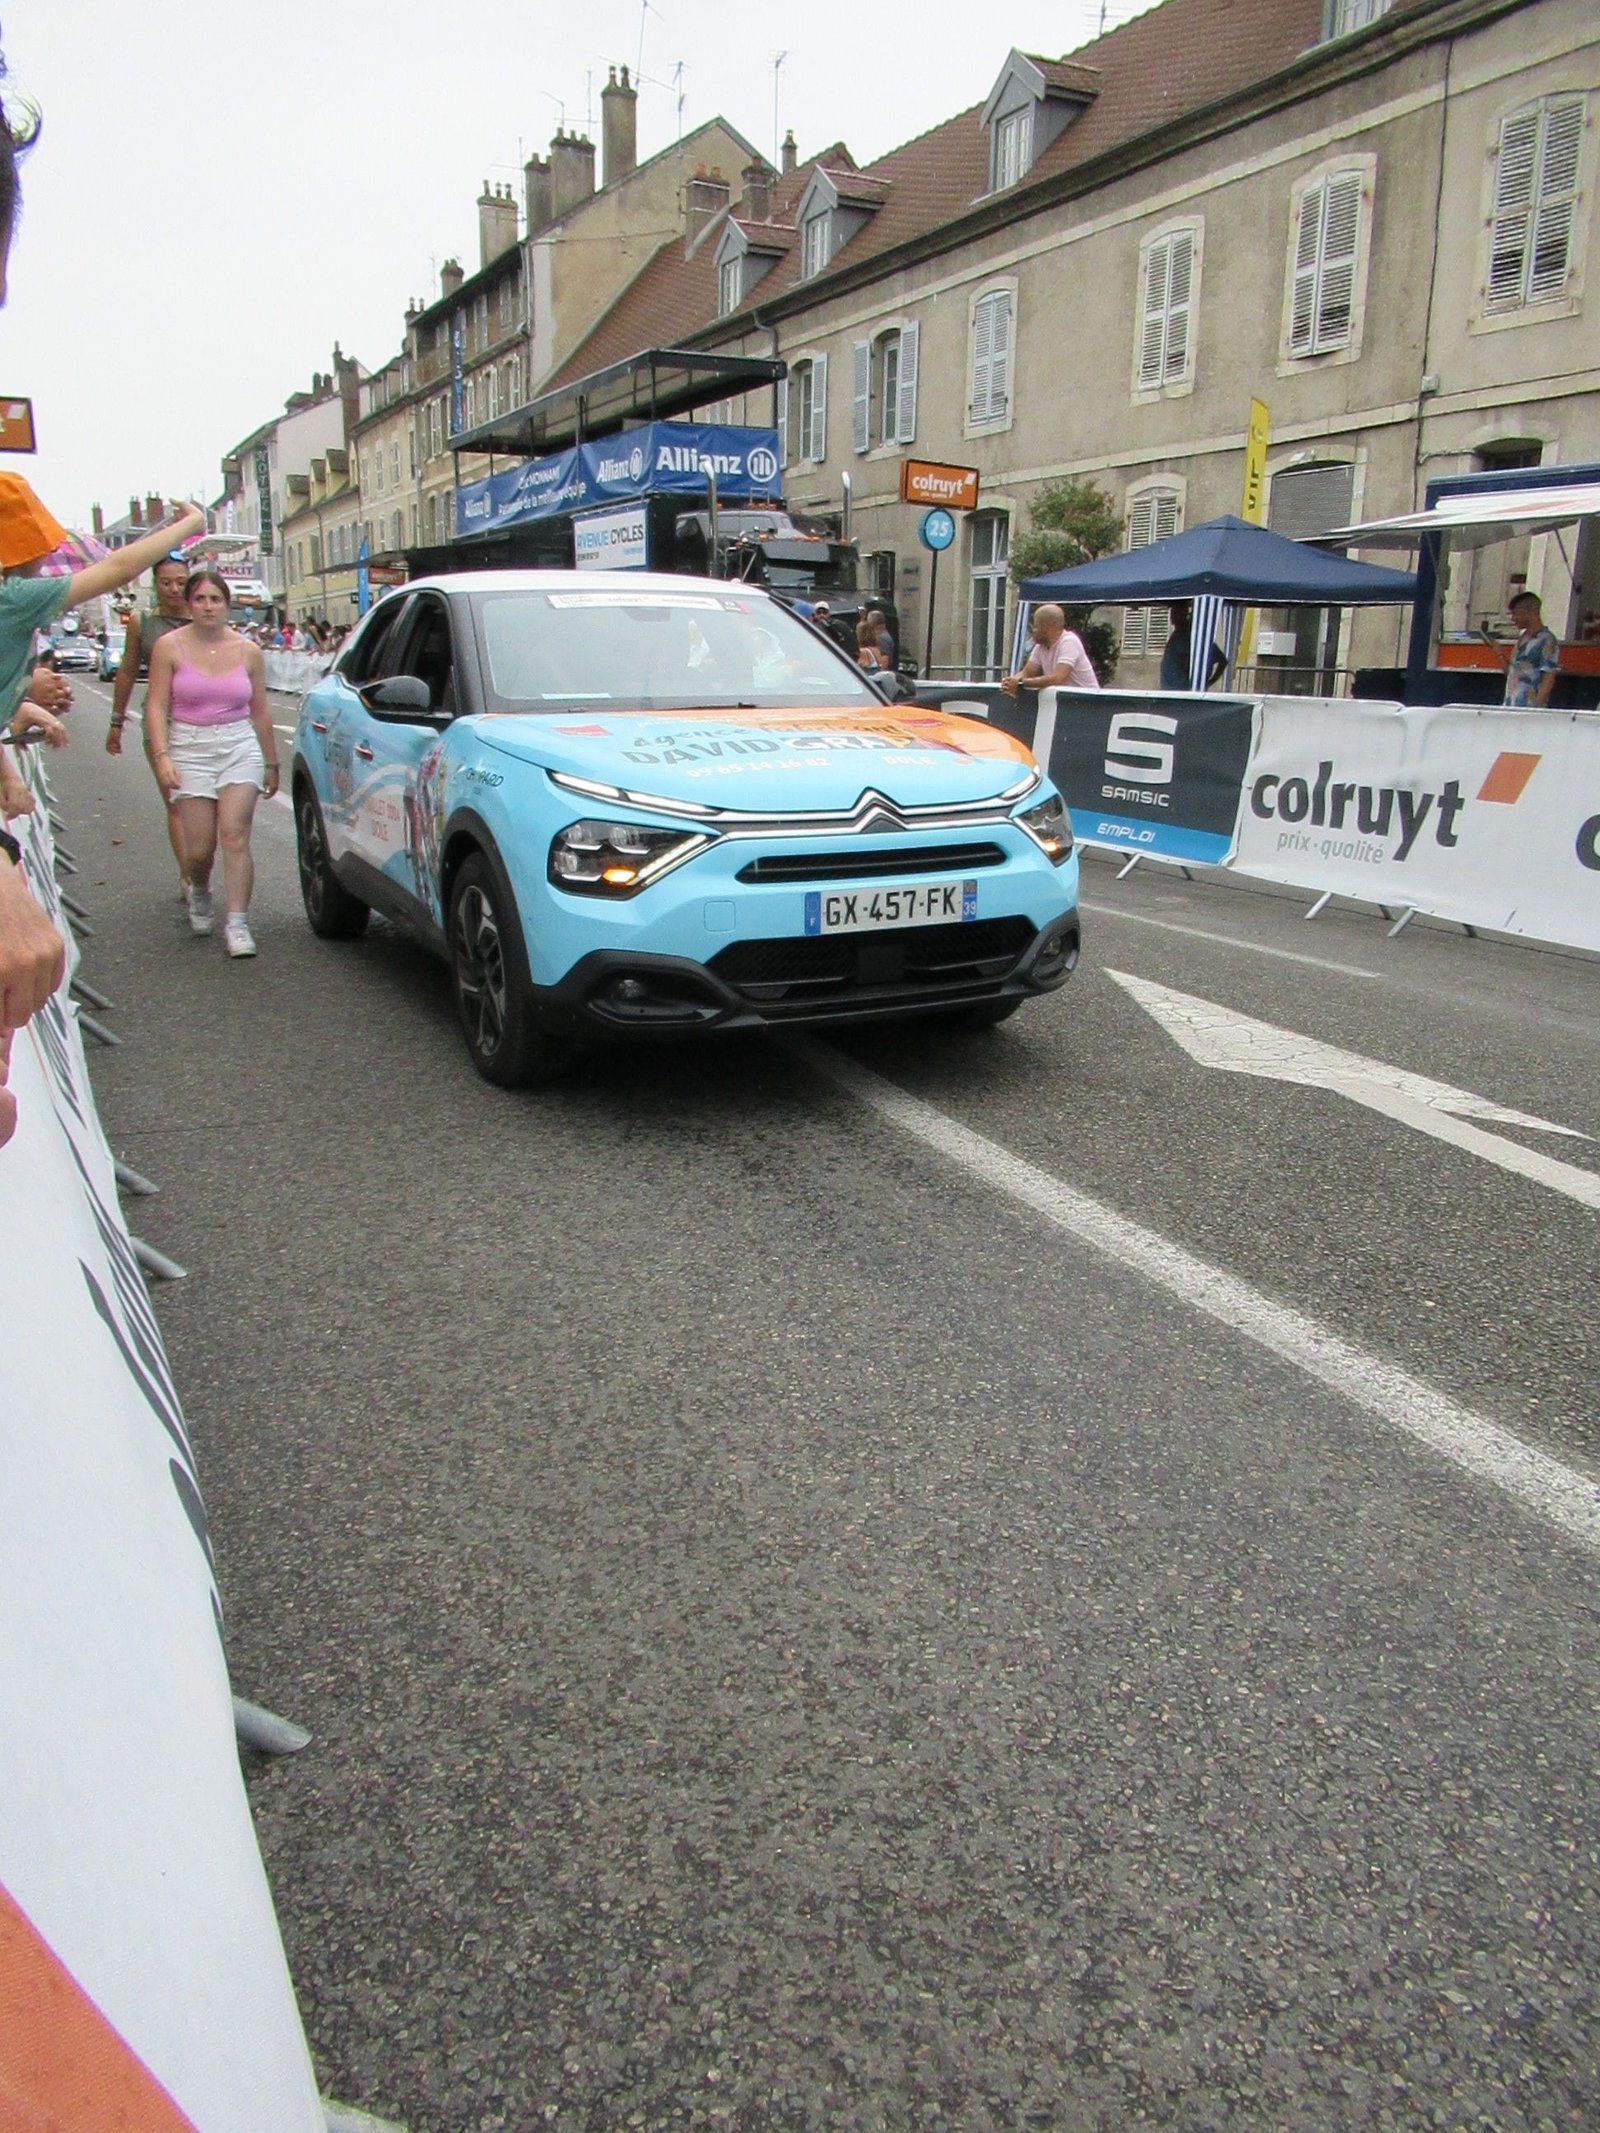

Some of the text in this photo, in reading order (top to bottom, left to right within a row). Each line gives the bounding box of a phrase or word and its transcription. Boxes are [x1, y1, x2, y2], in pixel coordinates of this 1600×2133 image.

[596, 459, 629, 484] Allianz
[656, 446, 743, 475] Allianz
[912, 473, 963, 498] colruyt
[577, 524, 643, 550] AVENUE CYCLES
[930, 520, 949, 538] 25
[620, 738, 780, 765] DAVID
[718, 761, 746, 776] 65
[1101, 785, 1170, 807] SAMSIC
[1251, 760, 1465, 862] colruyt
[1096, 823, 1156, 843] EMPLOI
[1277, 830, 1385, 865] prix qualité
[825, 886, 957, 927] GX-457-FK
[963, 901, 976, 916] 39
[809, 917, 816, 927] F
